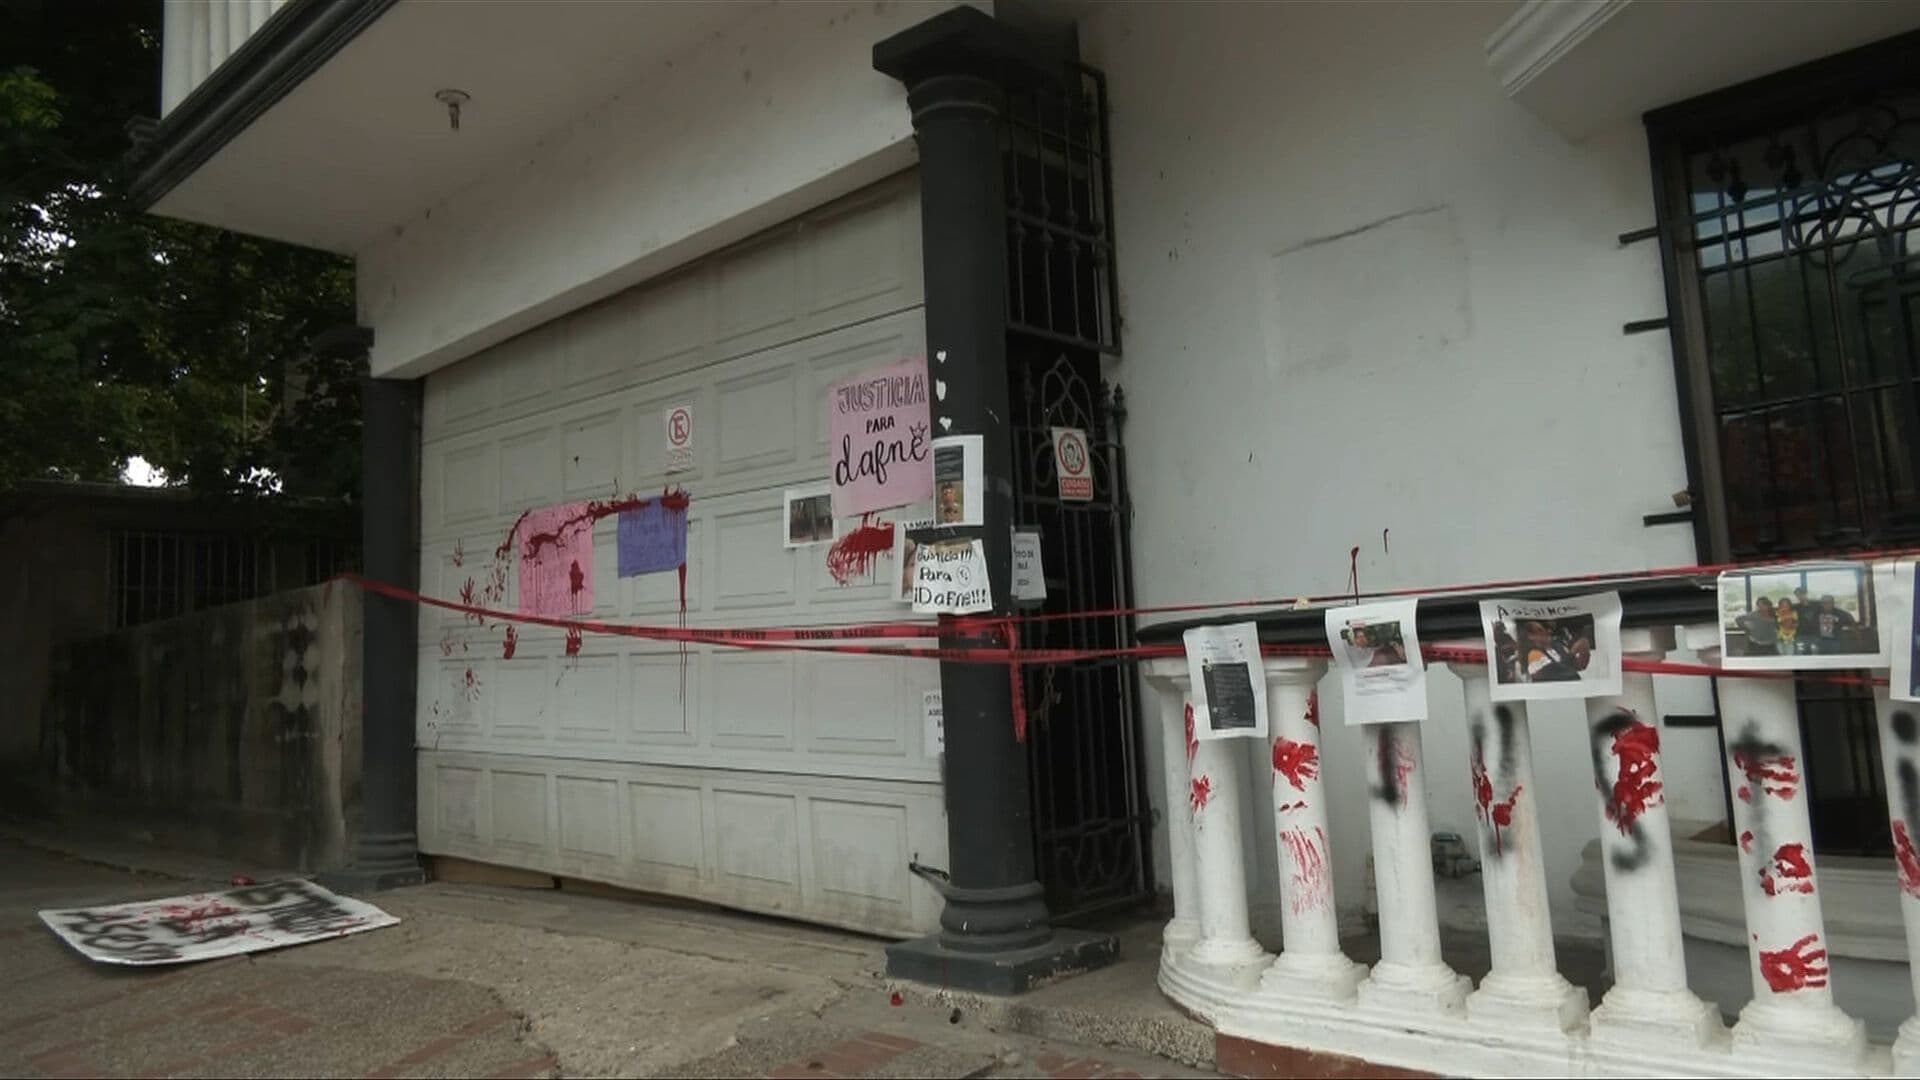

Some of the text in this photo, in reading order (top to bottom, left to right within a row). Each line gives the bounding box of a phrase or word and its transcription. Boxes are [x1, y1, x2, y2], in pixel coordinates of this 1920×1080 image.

[837, 374, 926, 414] JUSTICIA
[866, 415, 895, 434] PARA
[920, 567, 953, 582] Para
